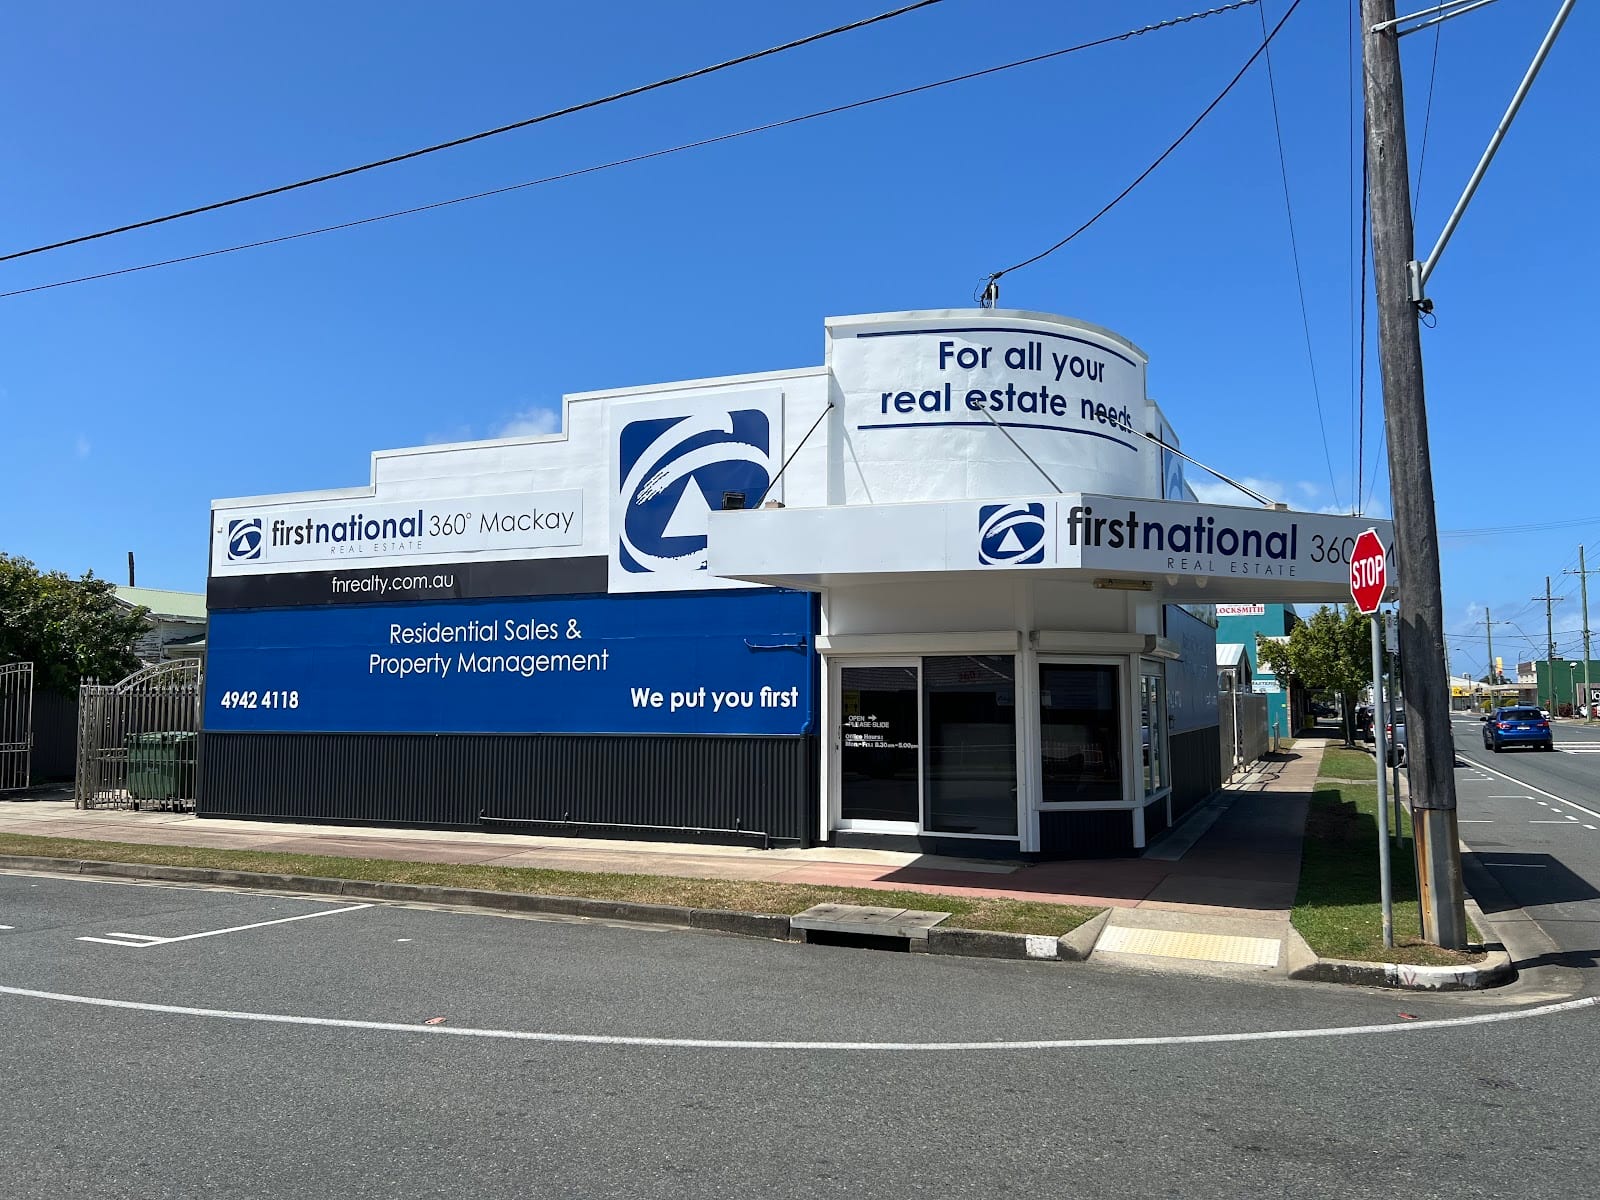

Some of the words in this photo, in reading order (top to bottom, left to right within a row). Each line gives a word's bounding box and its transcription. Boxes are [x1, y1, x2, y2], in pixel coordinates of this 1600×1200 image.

[938, 341, 993, 370] For
[1004, 341, 1042, 371] all
[1052, 352, 1105, 383] your
[881, 383, 951, 414] real
[965, 383, 1067, 416] estate
[1081, 398, 1133, 434] needs
[479, 508, 574, 534] Mackay
[374, 540, 422, 552] ESTATE
[1167, 557, 1215, 572] REAL
[1231, 561, 1297, 577] ESTATE
[1352, 555, 1384, 590] STOP
[331, 573, 454, 594] fnrealty.com.au
[390, 620, 498, 644] Residential
[504, 619, 559, 641] Sales
[565, 618, 582, 639] &
[369, 652, 452, 679] Property
[457, 648, 609, 677] Management
[221, 691, 257, 709] 4942
[261, 690, 299, 709] 4118
[630, 687, 664, 708] We
[670, 686, 706, 713] put
[711, 691, 753, 713] you
[759, 685, 799, 708] first
[872, 721, 890, 729] SLIDE
